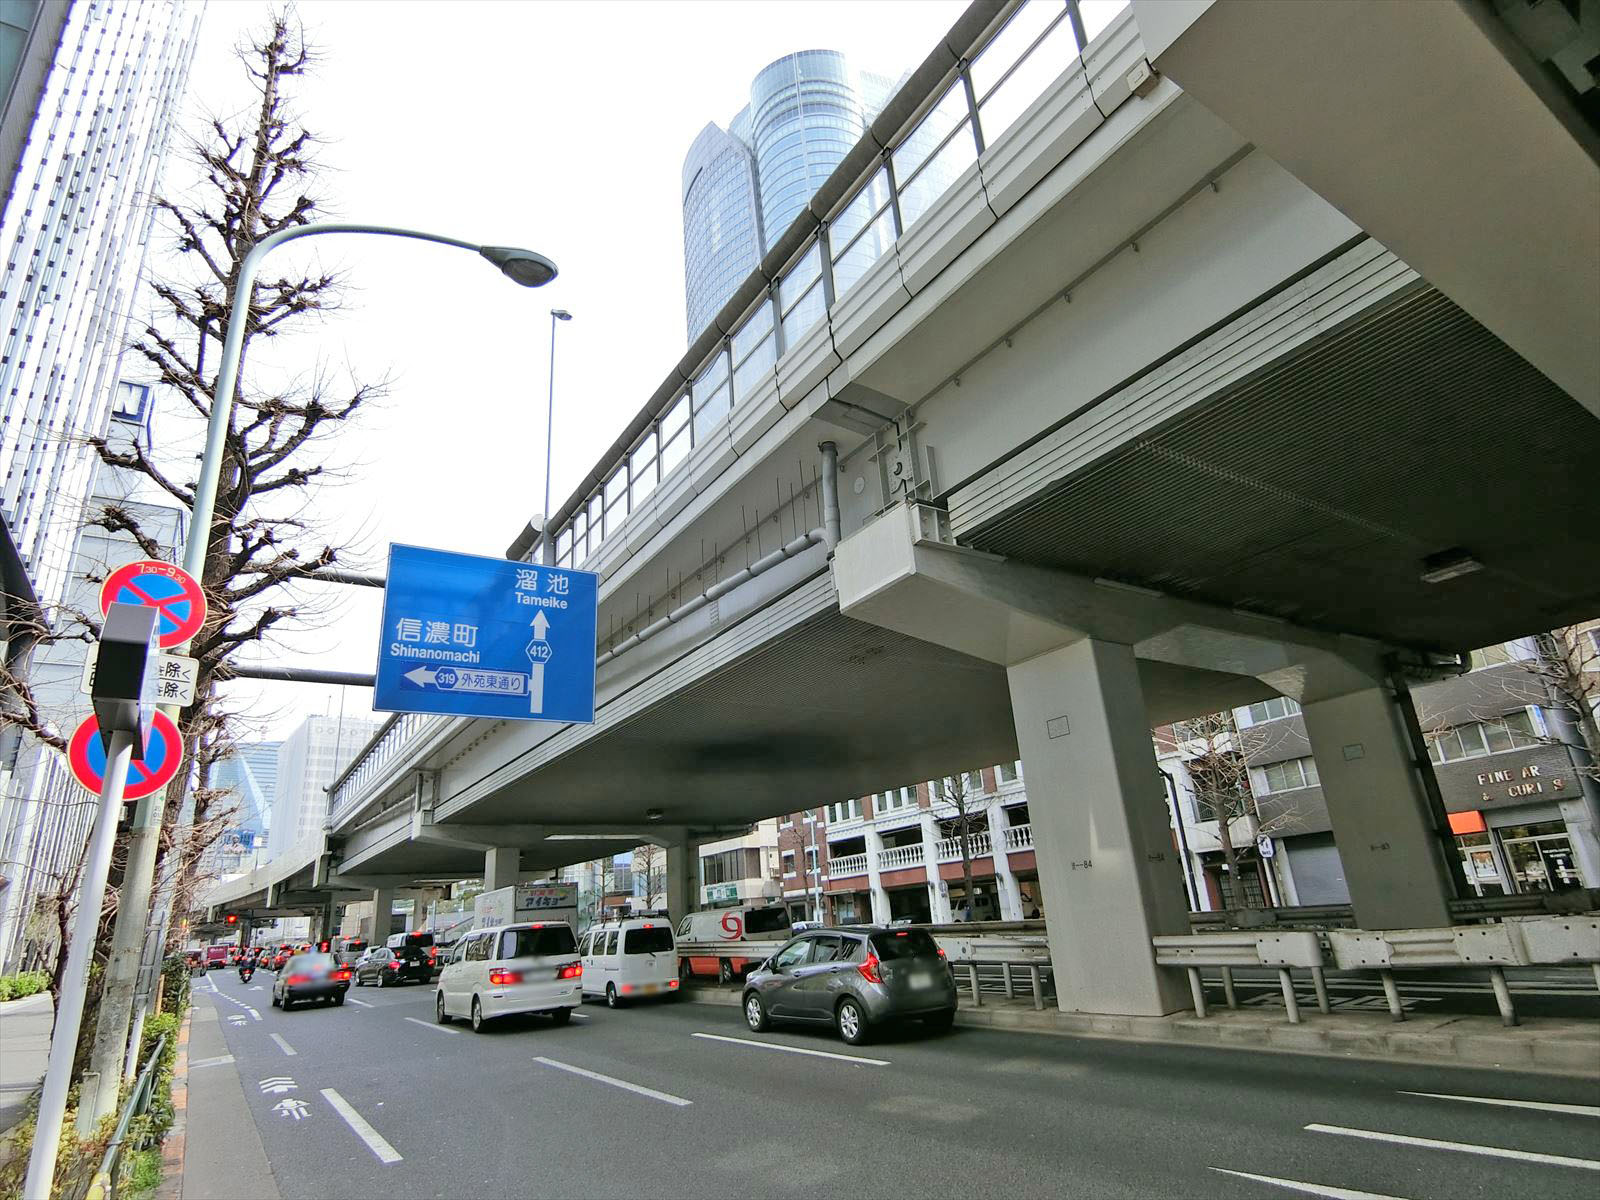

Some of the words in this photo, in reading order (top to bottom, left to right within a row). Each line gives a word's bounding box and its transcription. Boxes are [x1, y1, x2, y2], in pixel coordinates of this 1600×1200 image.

[515, 592, 568, 609] Tameike
[395, 617, 479, 648] 信濃町
[390, 642, 480, 664] Shinanomachi
[529, 644, 549, 659] 412
[438, 672, 456, 685] 319
[461, 673, 521, 691] 外苑東通り
[1477, 769, 1513, 786] FINE
[1521, 765, 1540, 779] AR
